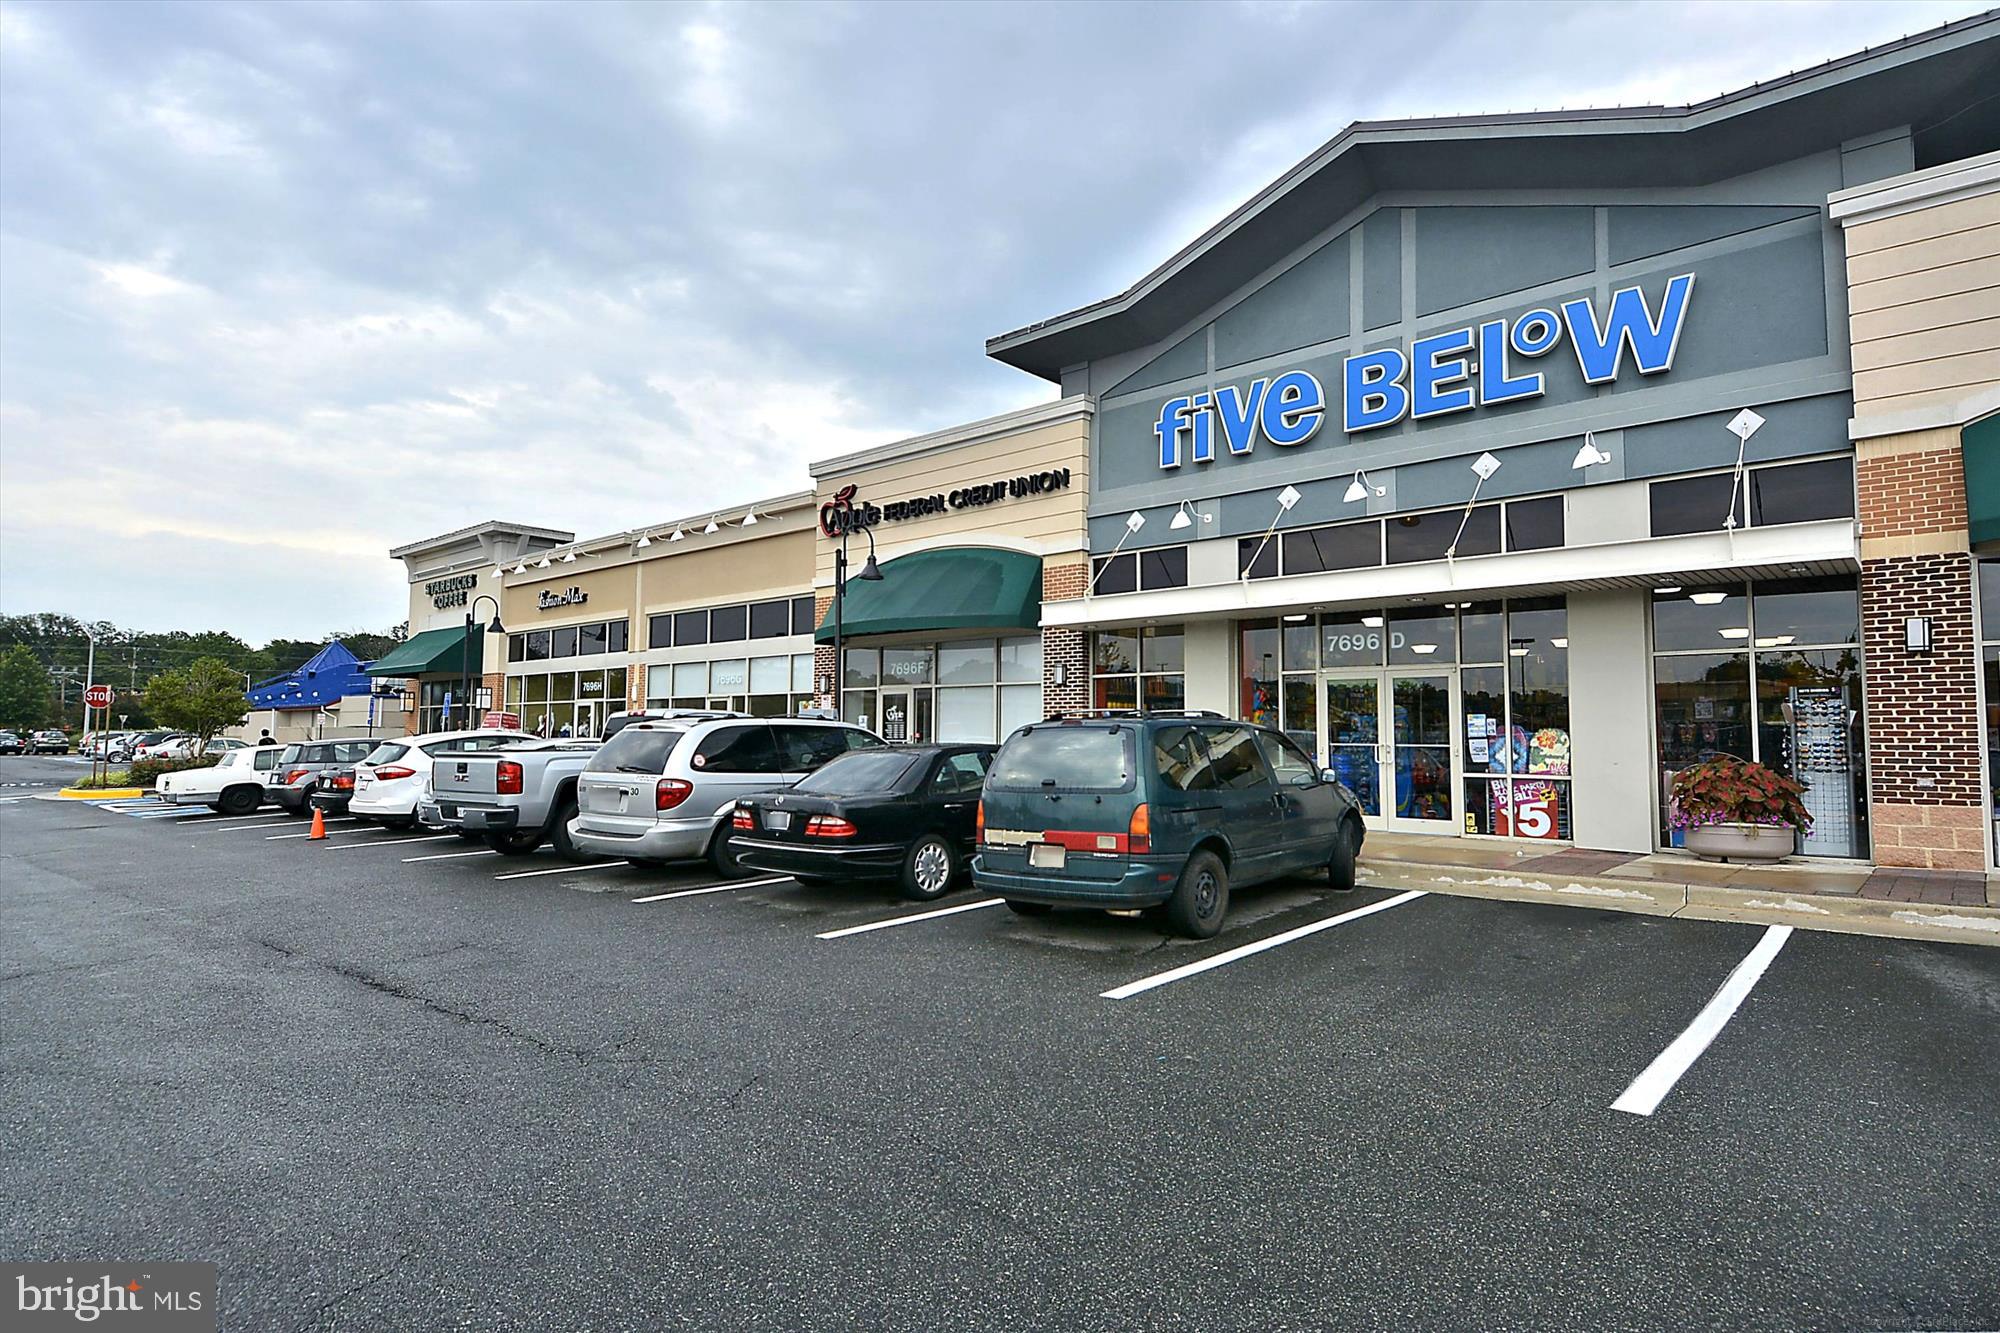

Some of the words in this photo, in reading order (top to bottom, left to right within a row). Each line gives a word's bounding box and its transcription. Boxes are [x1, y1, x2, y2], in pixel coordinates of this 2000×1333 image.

[1343, 272, 1697, 434] BELOW
[883, 493, 948, 522] FEDERAL
[948, 480, 1007, 509] CREDIT
[1009, 467, 1070, 498] UNION
[425, 574, 477, 596] STARBUCKS
[434, 590, 468, 609] COFFEE
[1327, 633, 1380, 652] 7696
[1391, 632, 1405, 649] D
[890, 661, 925, 675] 7696F
[582, 681, 602, 691] 7696H
[630, 787, 640, 796] 30
